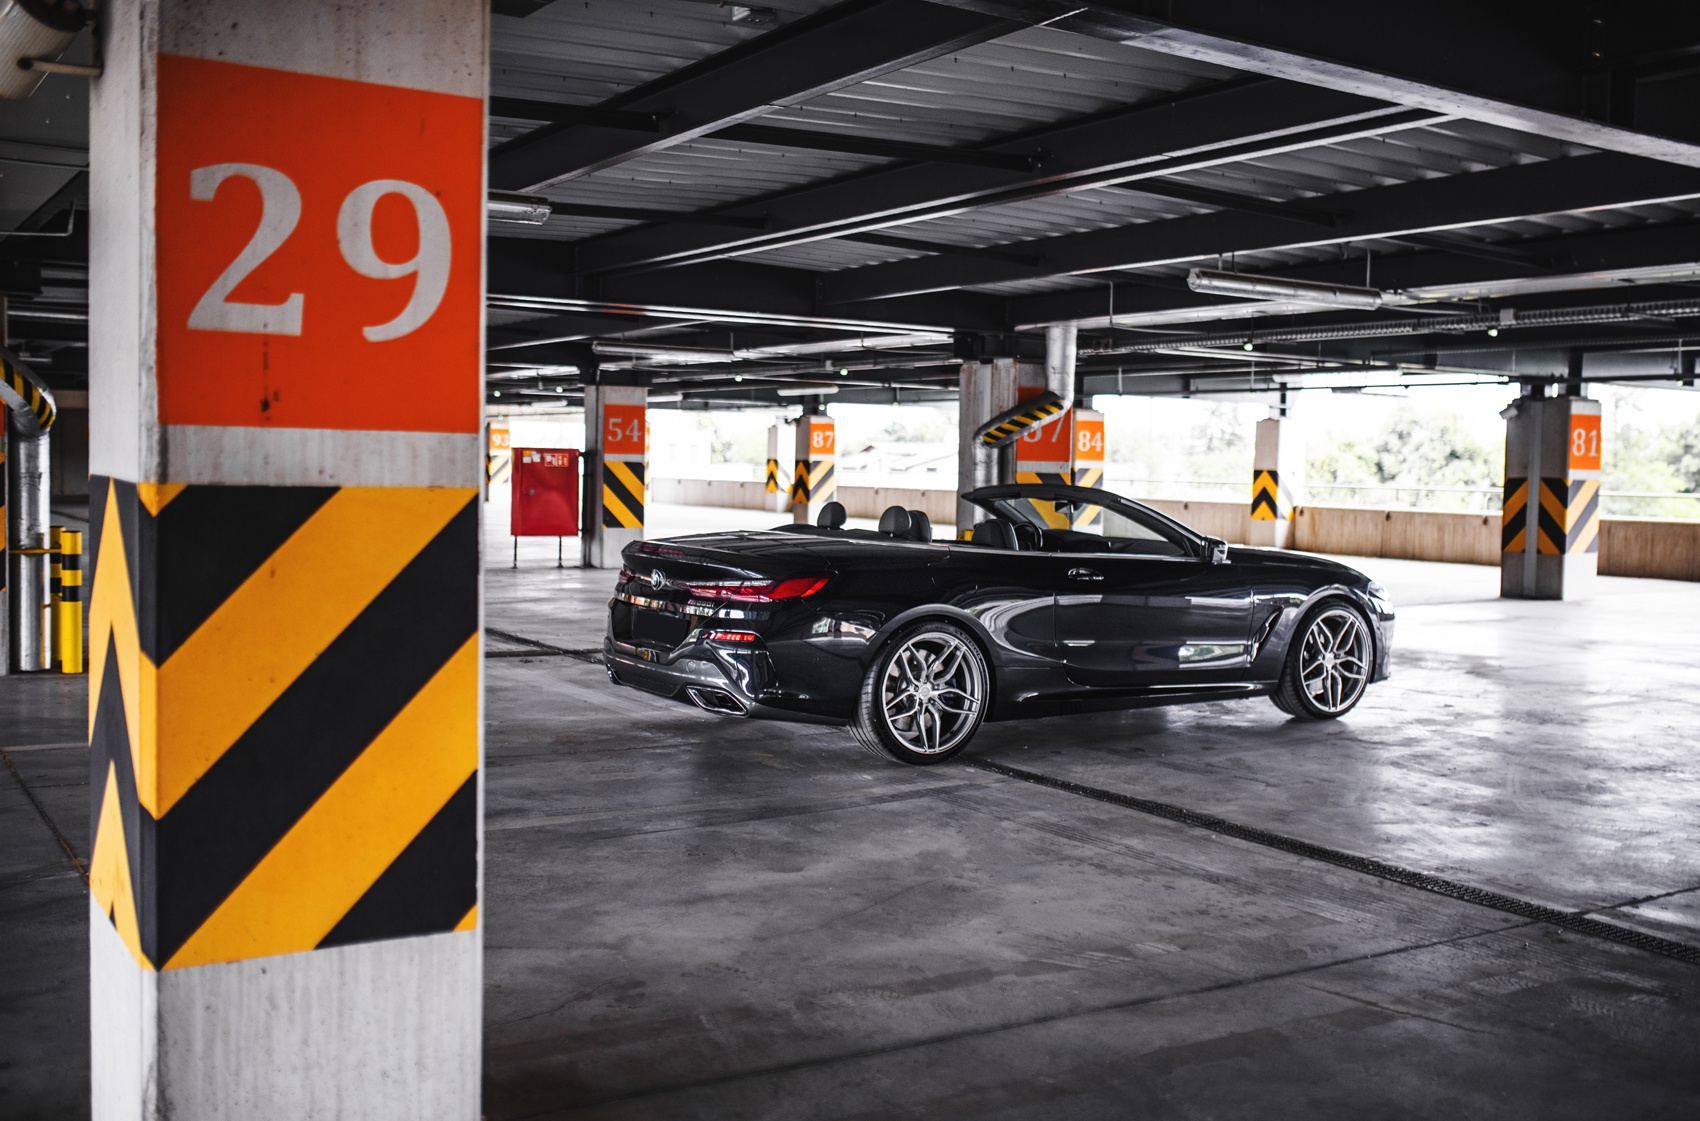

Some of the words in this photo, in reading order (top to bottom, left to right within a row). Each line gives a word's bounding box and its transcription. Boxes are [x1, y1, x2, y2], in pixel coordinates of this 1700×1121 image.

[188, 163, 451, 342] 29
[492, 433, 509, 446] 93
[608, 418, 641, 442] 54
[812, 431, 834, 449] 87
[1078, 431, 1103, 452] 84
[1572, 428, 1598, 457] 81
